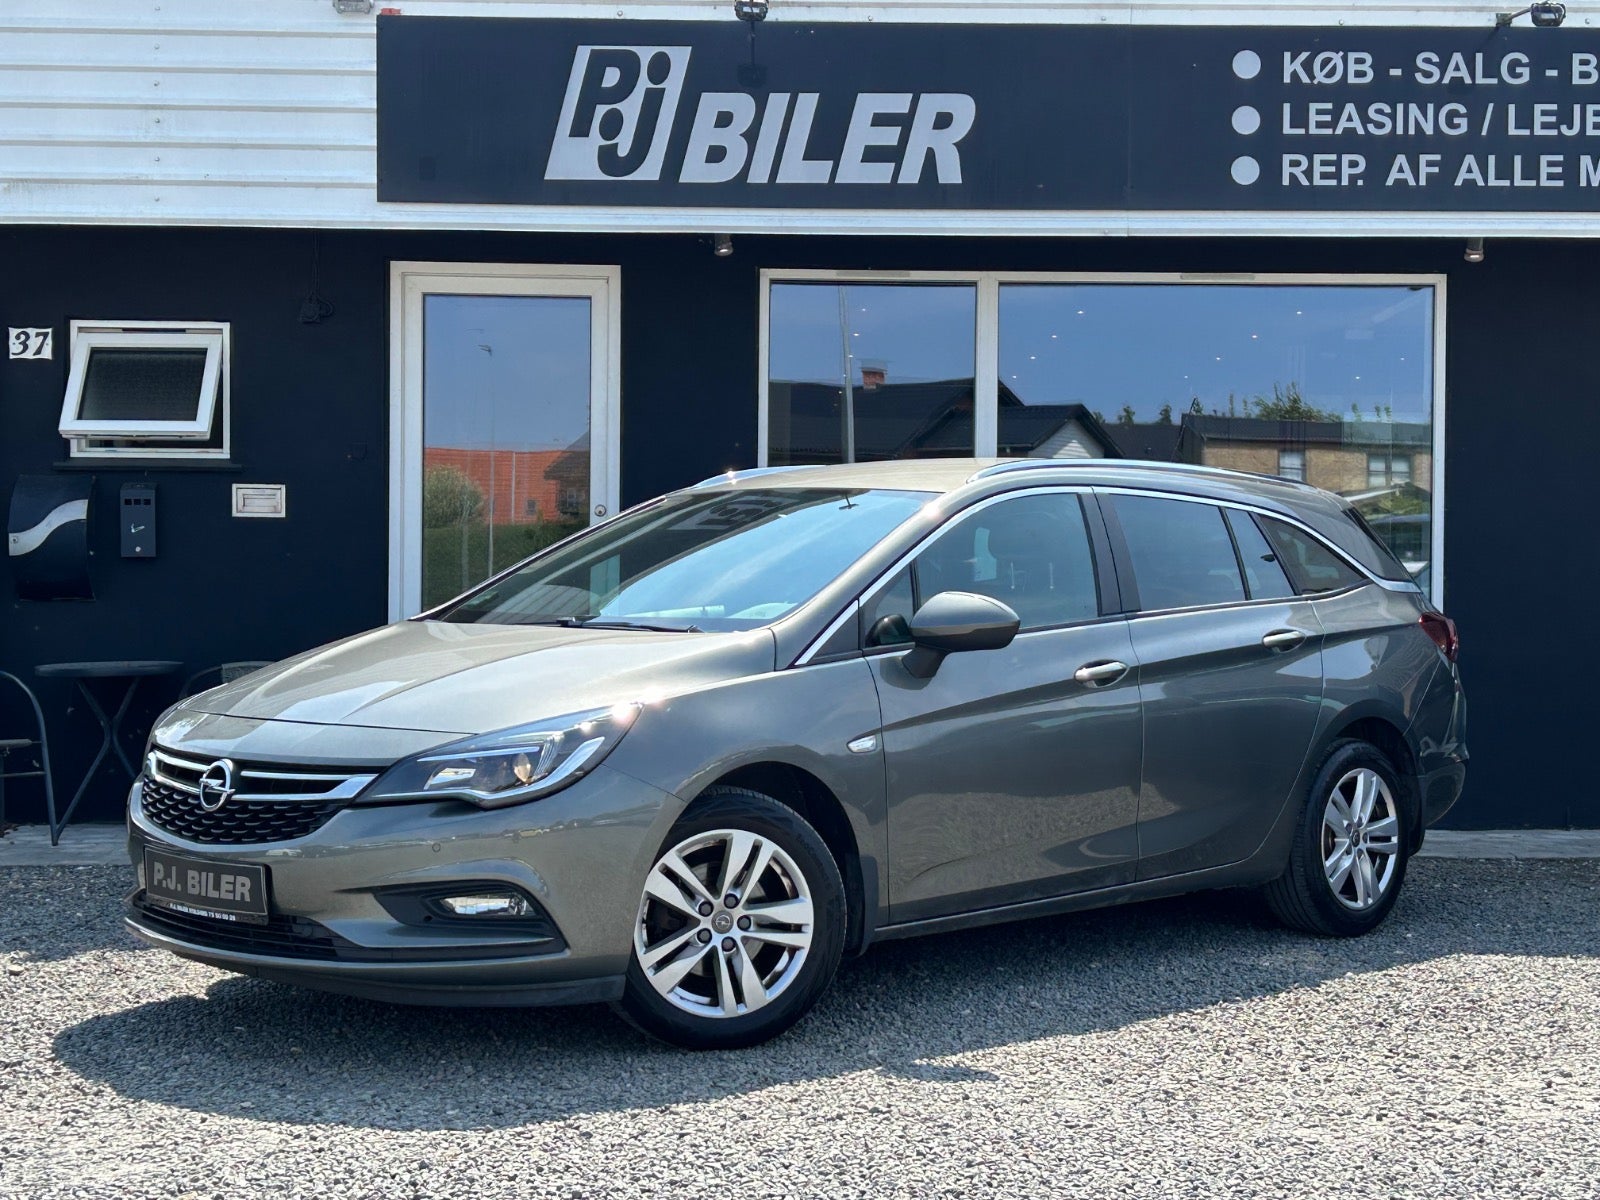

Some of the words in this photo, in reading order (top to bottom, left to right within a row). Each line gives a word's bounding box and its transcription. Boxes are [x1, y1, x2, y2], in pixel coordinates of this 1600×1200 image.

[1283, 51, 1374, 85] KØB
[1414, 51, 1530, 85] SALG
[1282, 102, 1468, 136] LEASING
[679, 92, 976, 184] BILER
[1281, 153, 1366, 186] REP.
[1385, 154, 1442, 186] AF
[1454, 154, 1564, 187] ALLE
[11, 330, 50, 356] 37
[153, 861, 182, 892] P.J.
[187, 869, 251, 902] BILER
